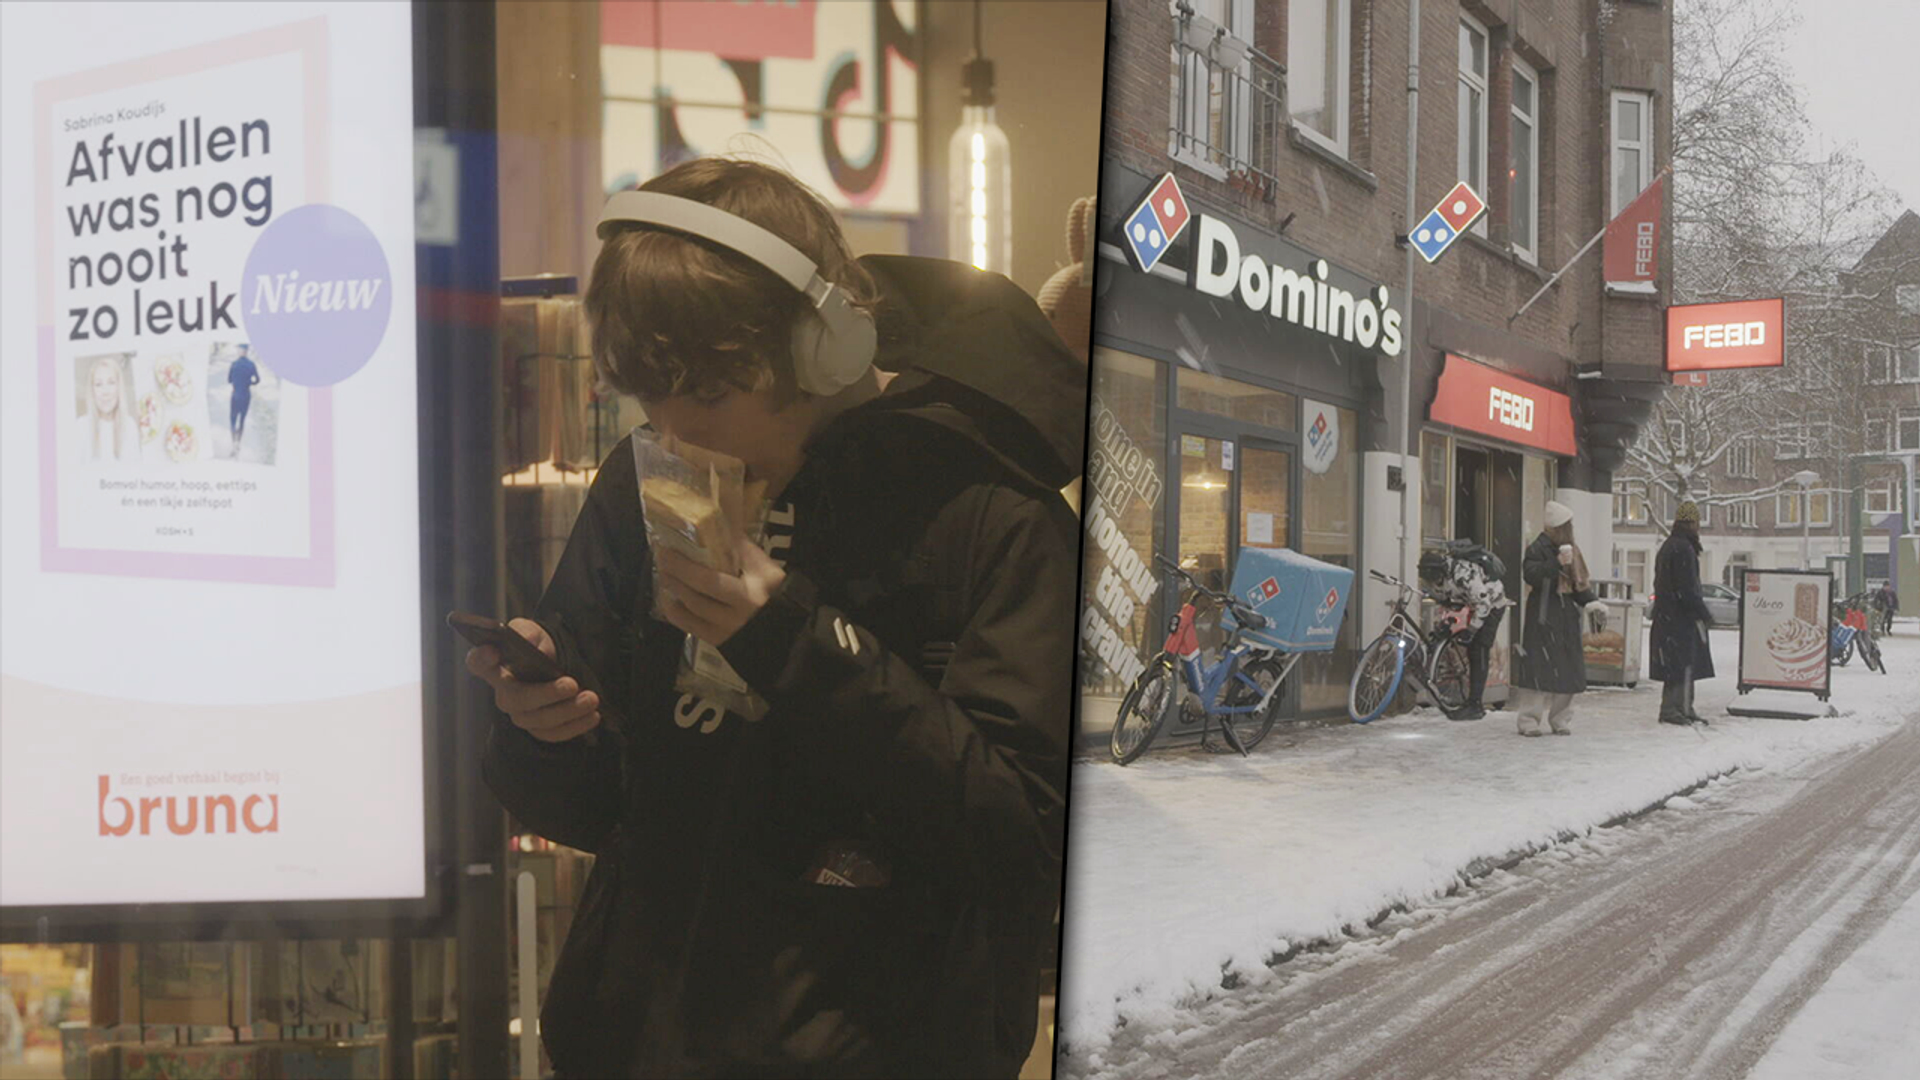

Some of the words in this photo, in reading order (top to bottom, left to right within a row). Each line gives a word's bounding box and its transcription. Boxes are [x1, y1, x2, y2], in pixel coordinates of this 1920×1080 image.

[63, 112, 114, 132] Sabrina
[117, 99, 166, 121] Koudijs
[66, 116, 270, 187] Afvallen
[67, 193, 160, 237] was
[176, 175, 272, 227] nog
[69, 230, 188, 290] nooit
[1635, 222, 1654, 275] FEBO
[69, 305, 118, 341] zo
[134, 281, 238, 336] leuk
[251, 270, 382, 315] Nieuw
[1196, 213, 1402, 356] Domino's
[1684, 322, 1765, 349] FEBO
[1489, 386, 1534, 431] FEBO
[1087, 449, 1134, 518] and
[1135, 458, 1162, 510] in
[1085, 494, 1158, 605] honour
[1095, 564, 1135, 628] the
[98, 775, 278, 837] bruna
